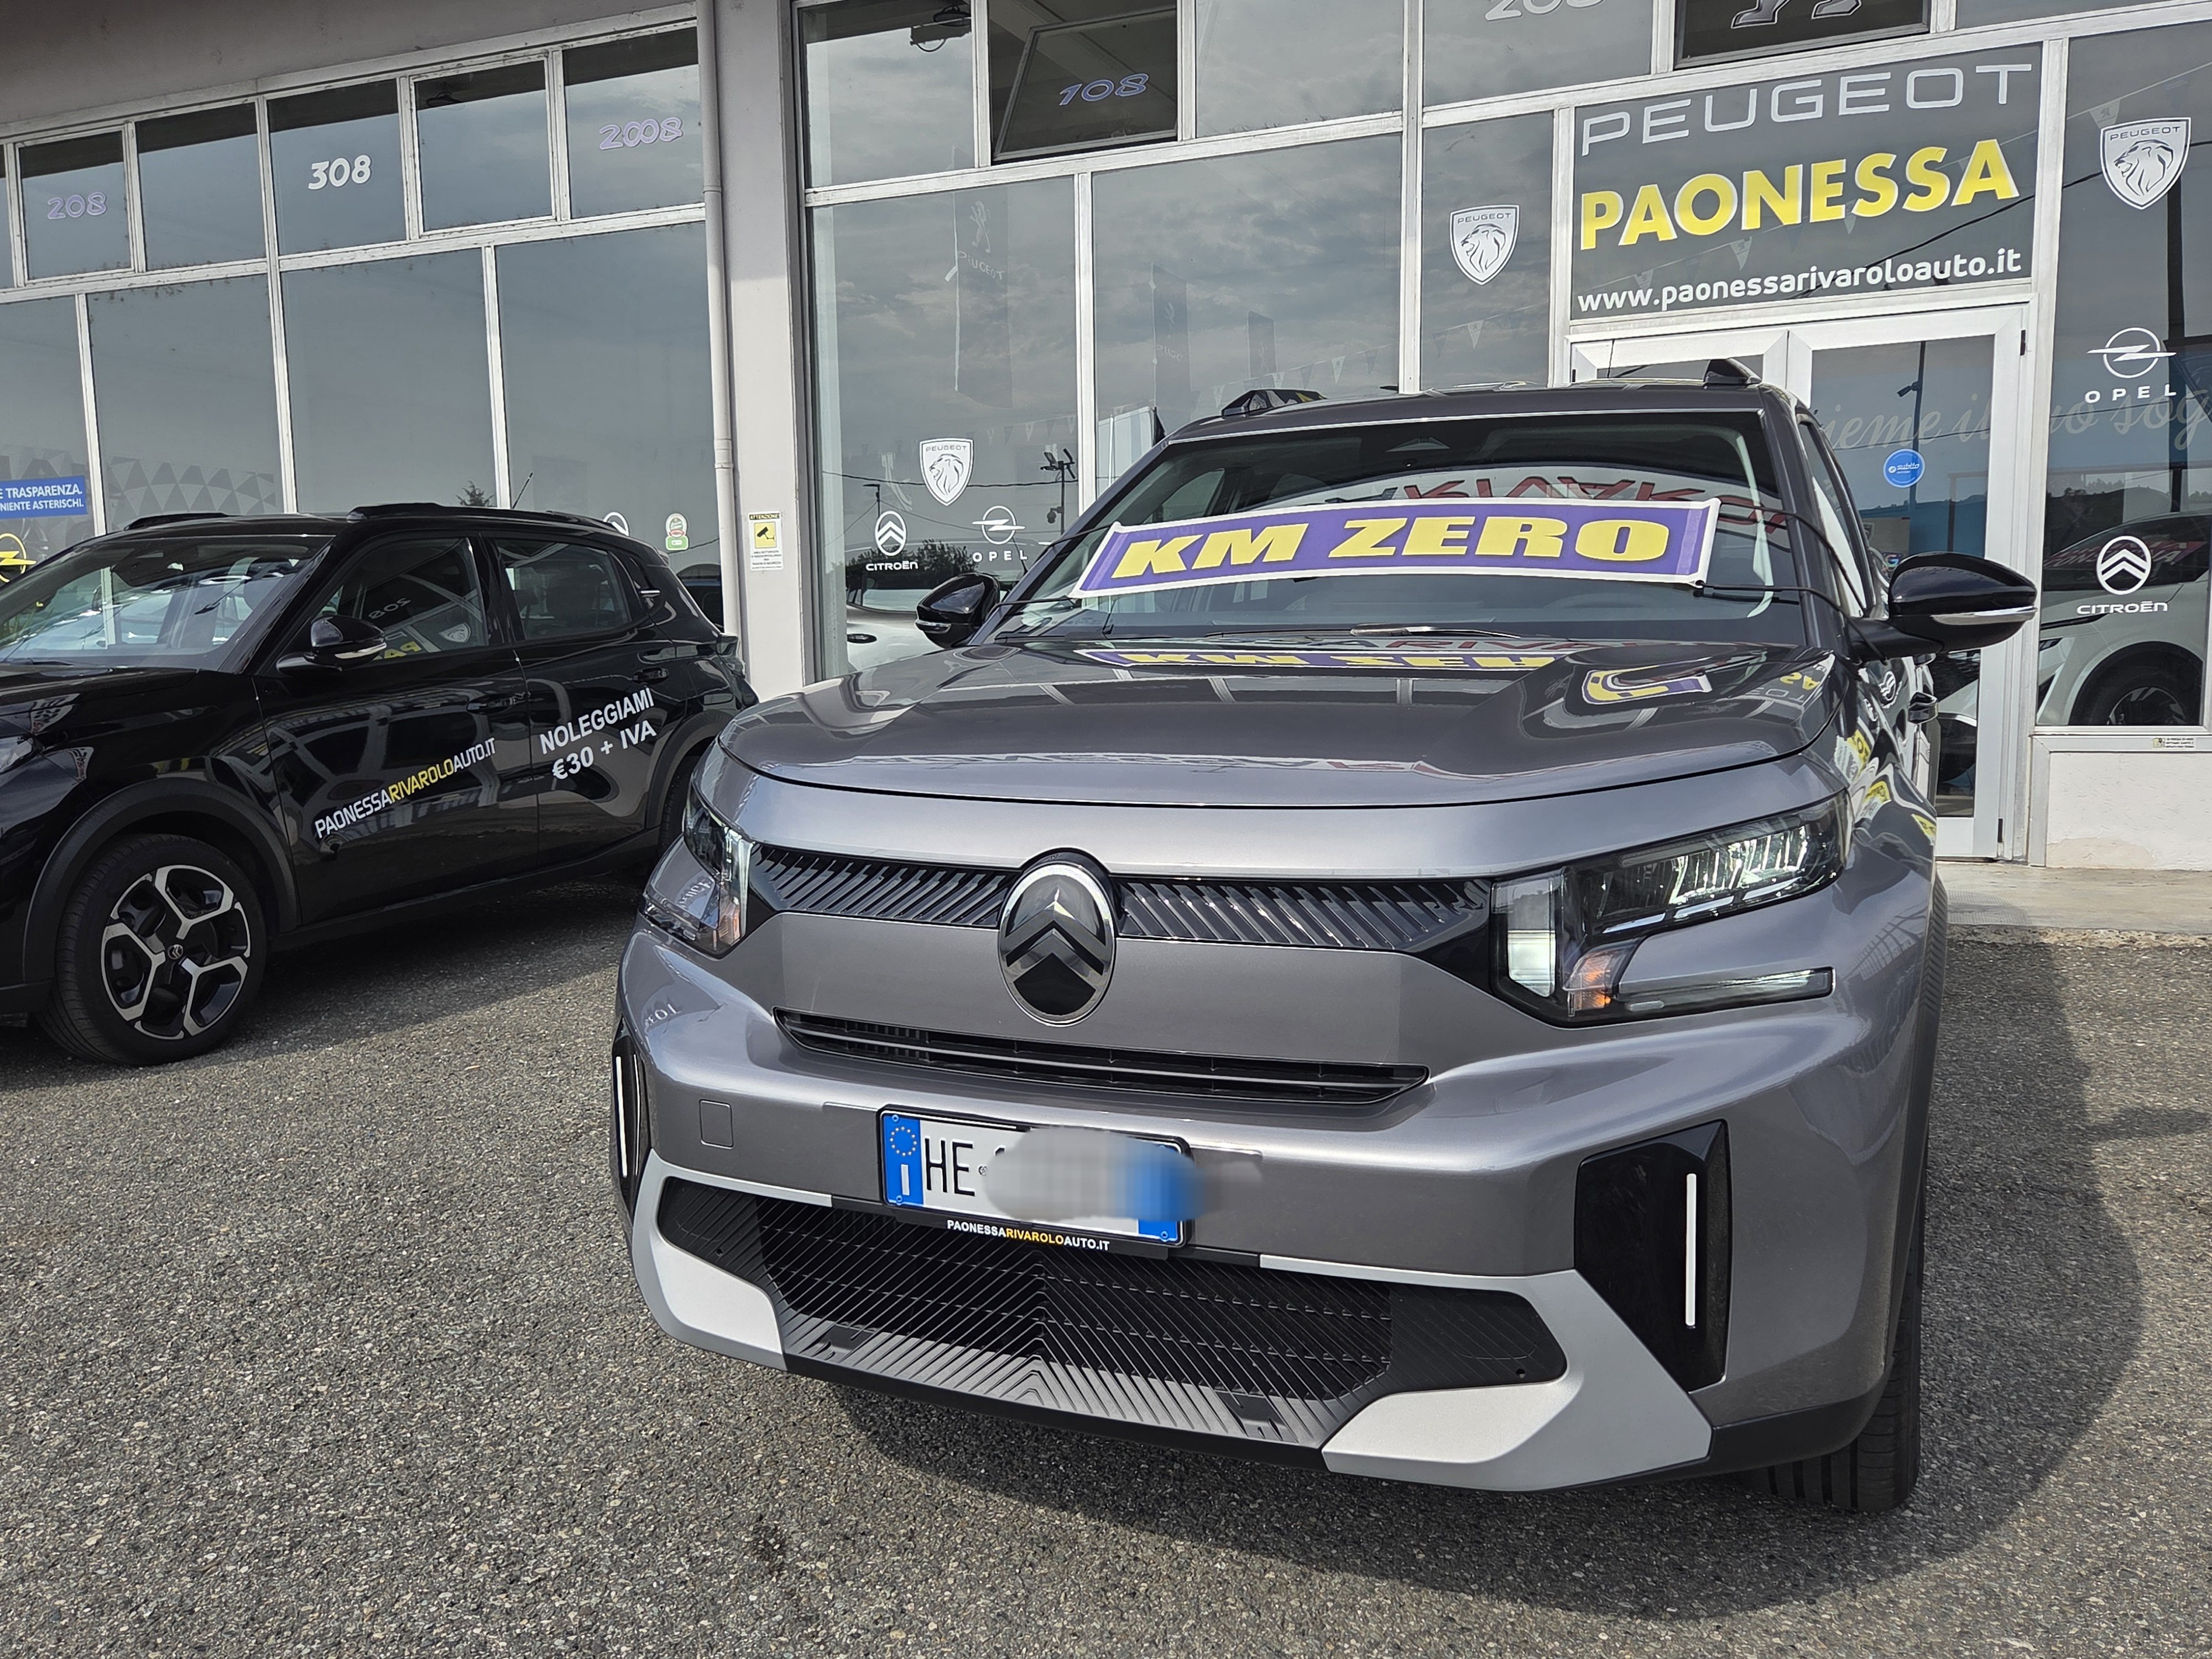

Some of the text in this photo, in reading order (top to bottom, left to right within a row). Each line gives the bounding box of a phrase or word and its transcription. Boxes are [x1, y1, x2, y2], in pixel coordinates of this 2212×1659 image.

[1058, 73, 1149, 106] 108
[1581, 64, 2032, 157] PEUGEOT
[599, 117, 683, 150] 2008
[2109, 125, 2181, 141] PEUGEOT
[308, 155, 372, 190] 308
[48, 192, 107, 220] 208
[1580, 139, 2020, 251] PAONESSA
[1457, 212, 1512, 225] PEUGEOT
[1578, 248, 2022, 311] www.paonessarivaroloauto.it
[2084, 384, 2177, 404] OPEL
[925, 444, 967, 452] PEUGEOT
[5, 483, 83, 499] TRASPARENZA.
[33, 498, 84, 510] ASTERISCHI.
[972, 549, 1027, 562] OPEL
[1110, 515, 1669, 578] KM ZERO
[539, 687, 655, 754] NOLEGGIAMI
[551, 720, 658, 780] €30 + IVA
[314, 737, 497, 838] PAONESSARIVAROLOAUTO.IT
[946, 1218, 1110, 1251] PAONESSARIVAROLOAUTO.IT
